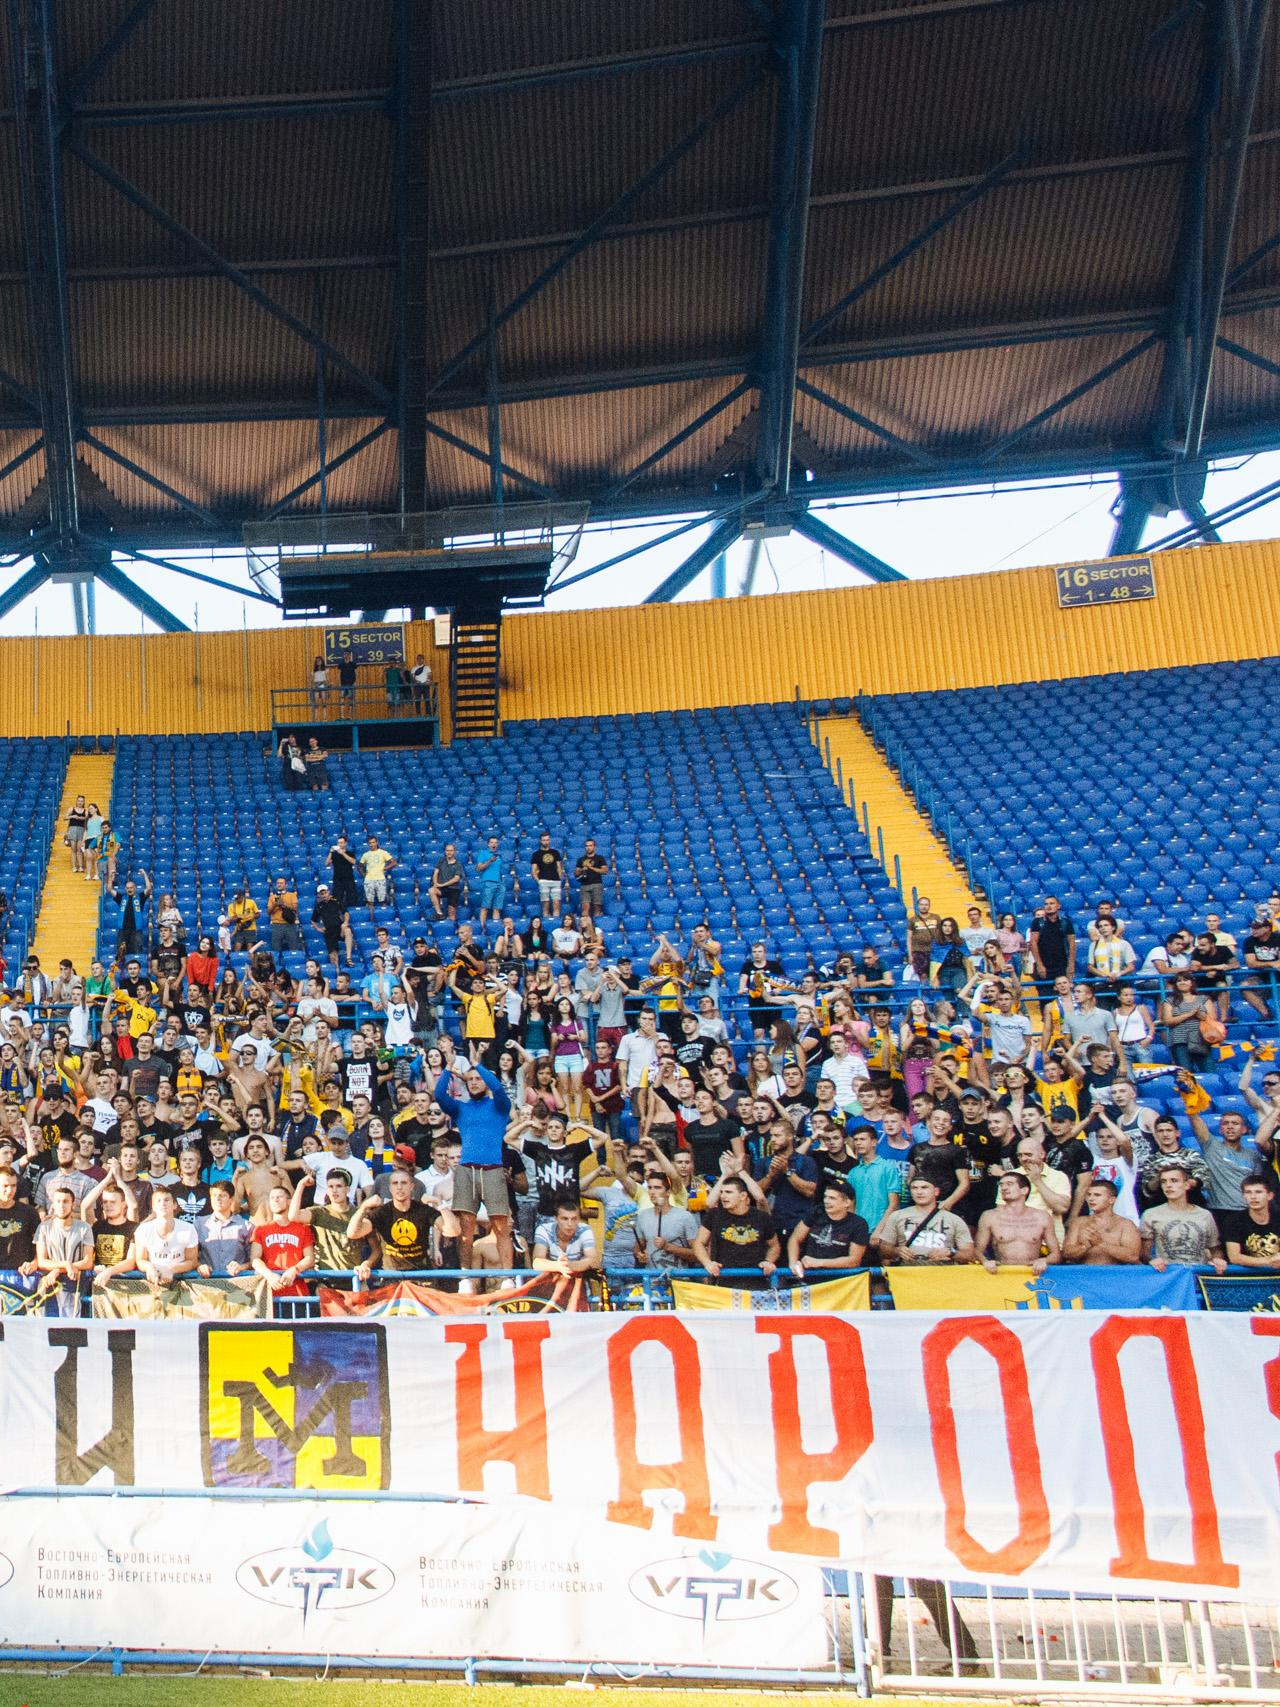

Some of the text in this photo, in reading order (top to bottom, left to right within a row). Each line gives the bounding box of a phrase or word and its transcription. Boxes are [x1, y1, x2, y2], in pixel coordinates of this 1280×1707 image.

[1059, 565, 1150, 588] 16 SECTOR
[1085, 589, 1094, 602] 1
[1110, 586, 1131, 599] 48
[327, 631, 401, 649] 15 SECTOR
[367, 650, 385, 662] 39
[594, 1069, 612, 1088] N
[265, 1233, 300, 1248] CHAMPION
